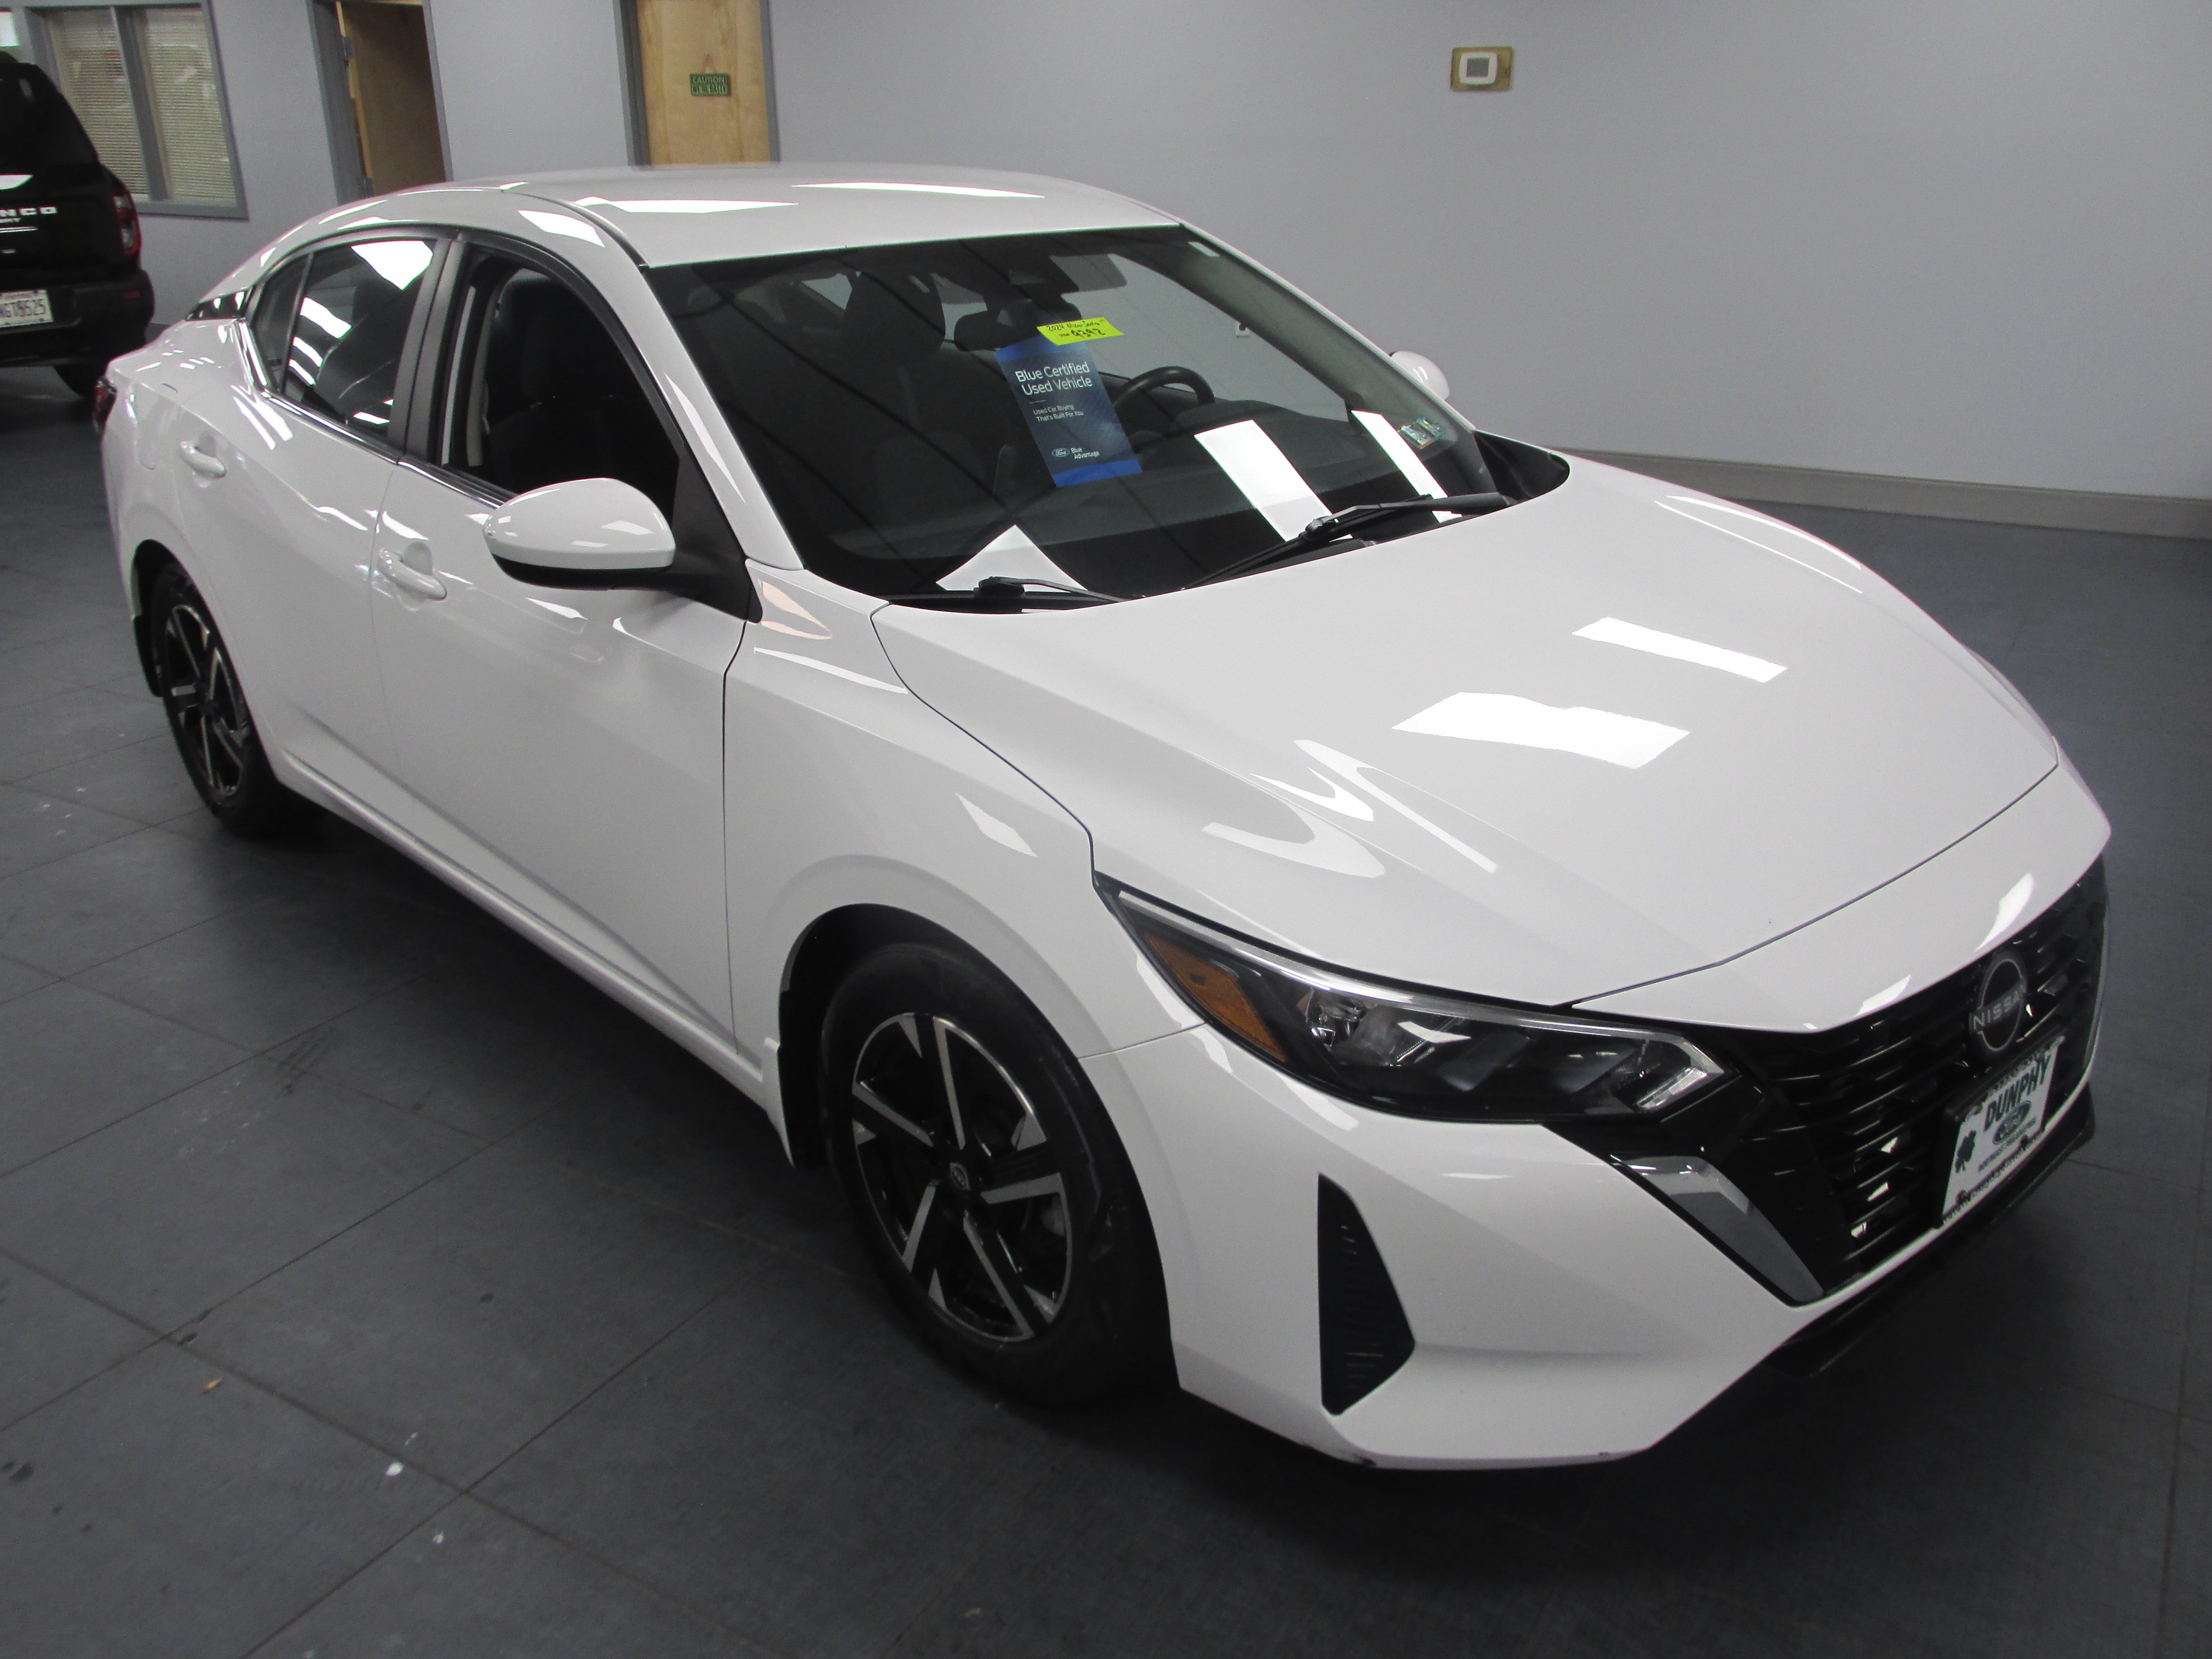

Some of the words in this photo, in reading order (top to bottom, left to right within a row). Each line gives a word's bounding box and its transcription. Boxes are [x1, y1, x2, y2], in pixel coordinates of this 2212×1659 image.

[1014, 369, 1044, 383] Blue
[1044, 361, 1090, 377] Certified
[1022, 380, 1054, 396] Used
[1052, 376, 1093, 390] Vehicle
[1073, 451, 1100, 459] Advantage
[1984, 1054, 2051, 1132] DUNPHY
